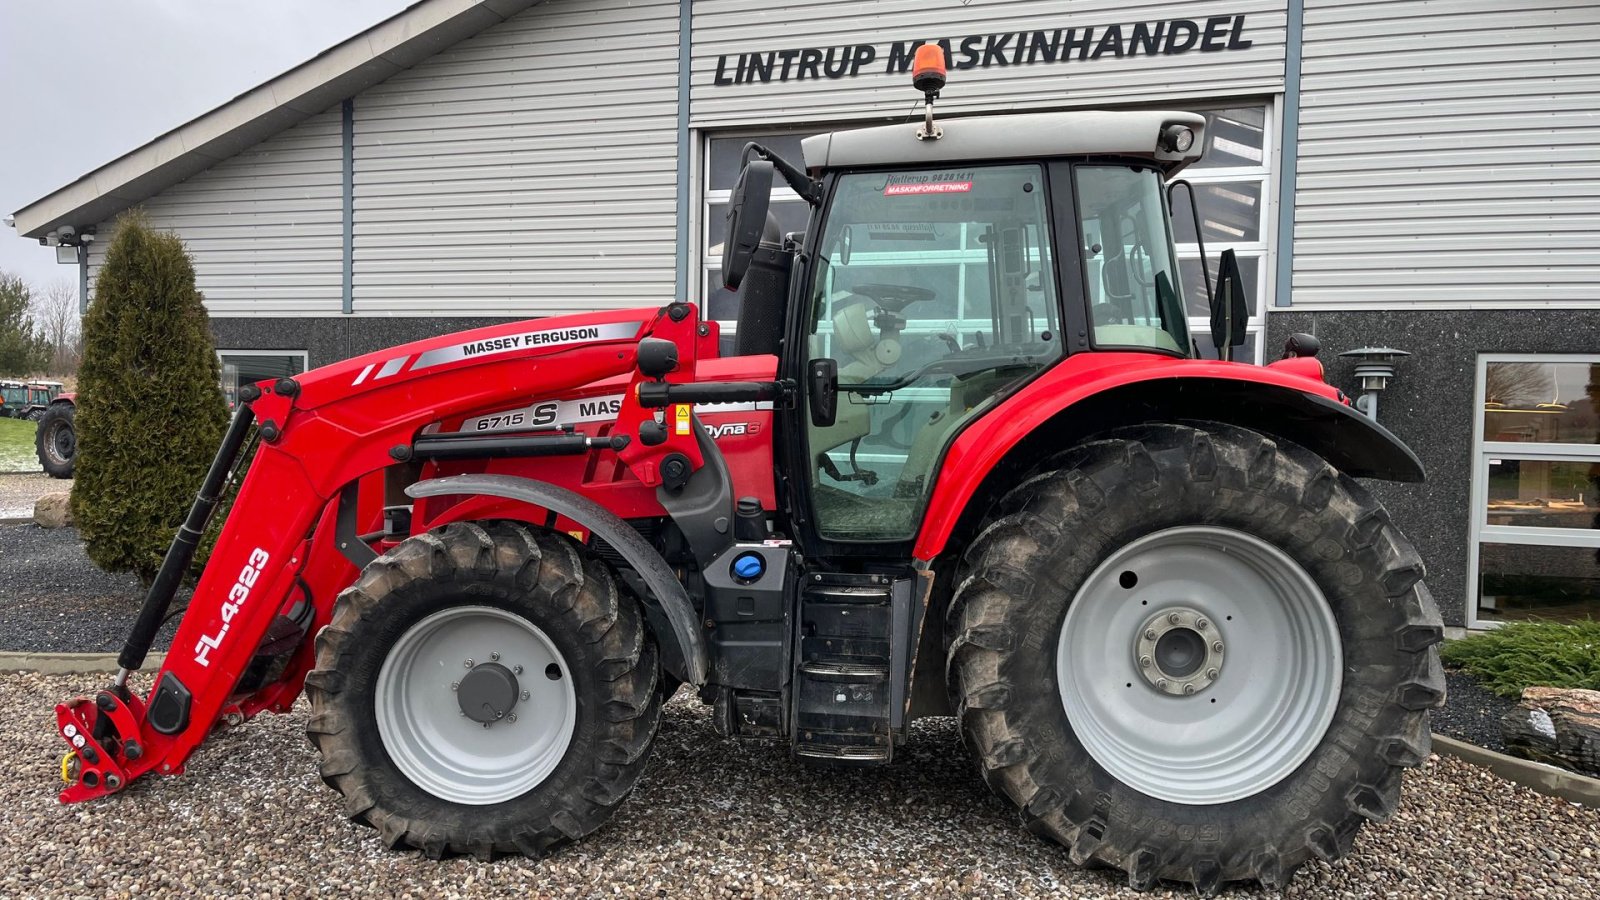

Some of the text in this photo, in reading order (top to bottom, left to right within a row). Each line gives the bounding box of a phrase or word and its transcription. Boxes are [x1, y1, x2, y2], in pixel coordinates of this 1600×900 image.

[714, 44, 876, 86] LINTRUP
[888, 183, 968, 193] MASKINFORRETNING
[463, 327, 599, 356] MASSEY FERGUSON
[477, 413, 524, 431] 6715
[532, 403, 558, 426] S
[194, 547, 270, 667] FL.4323
